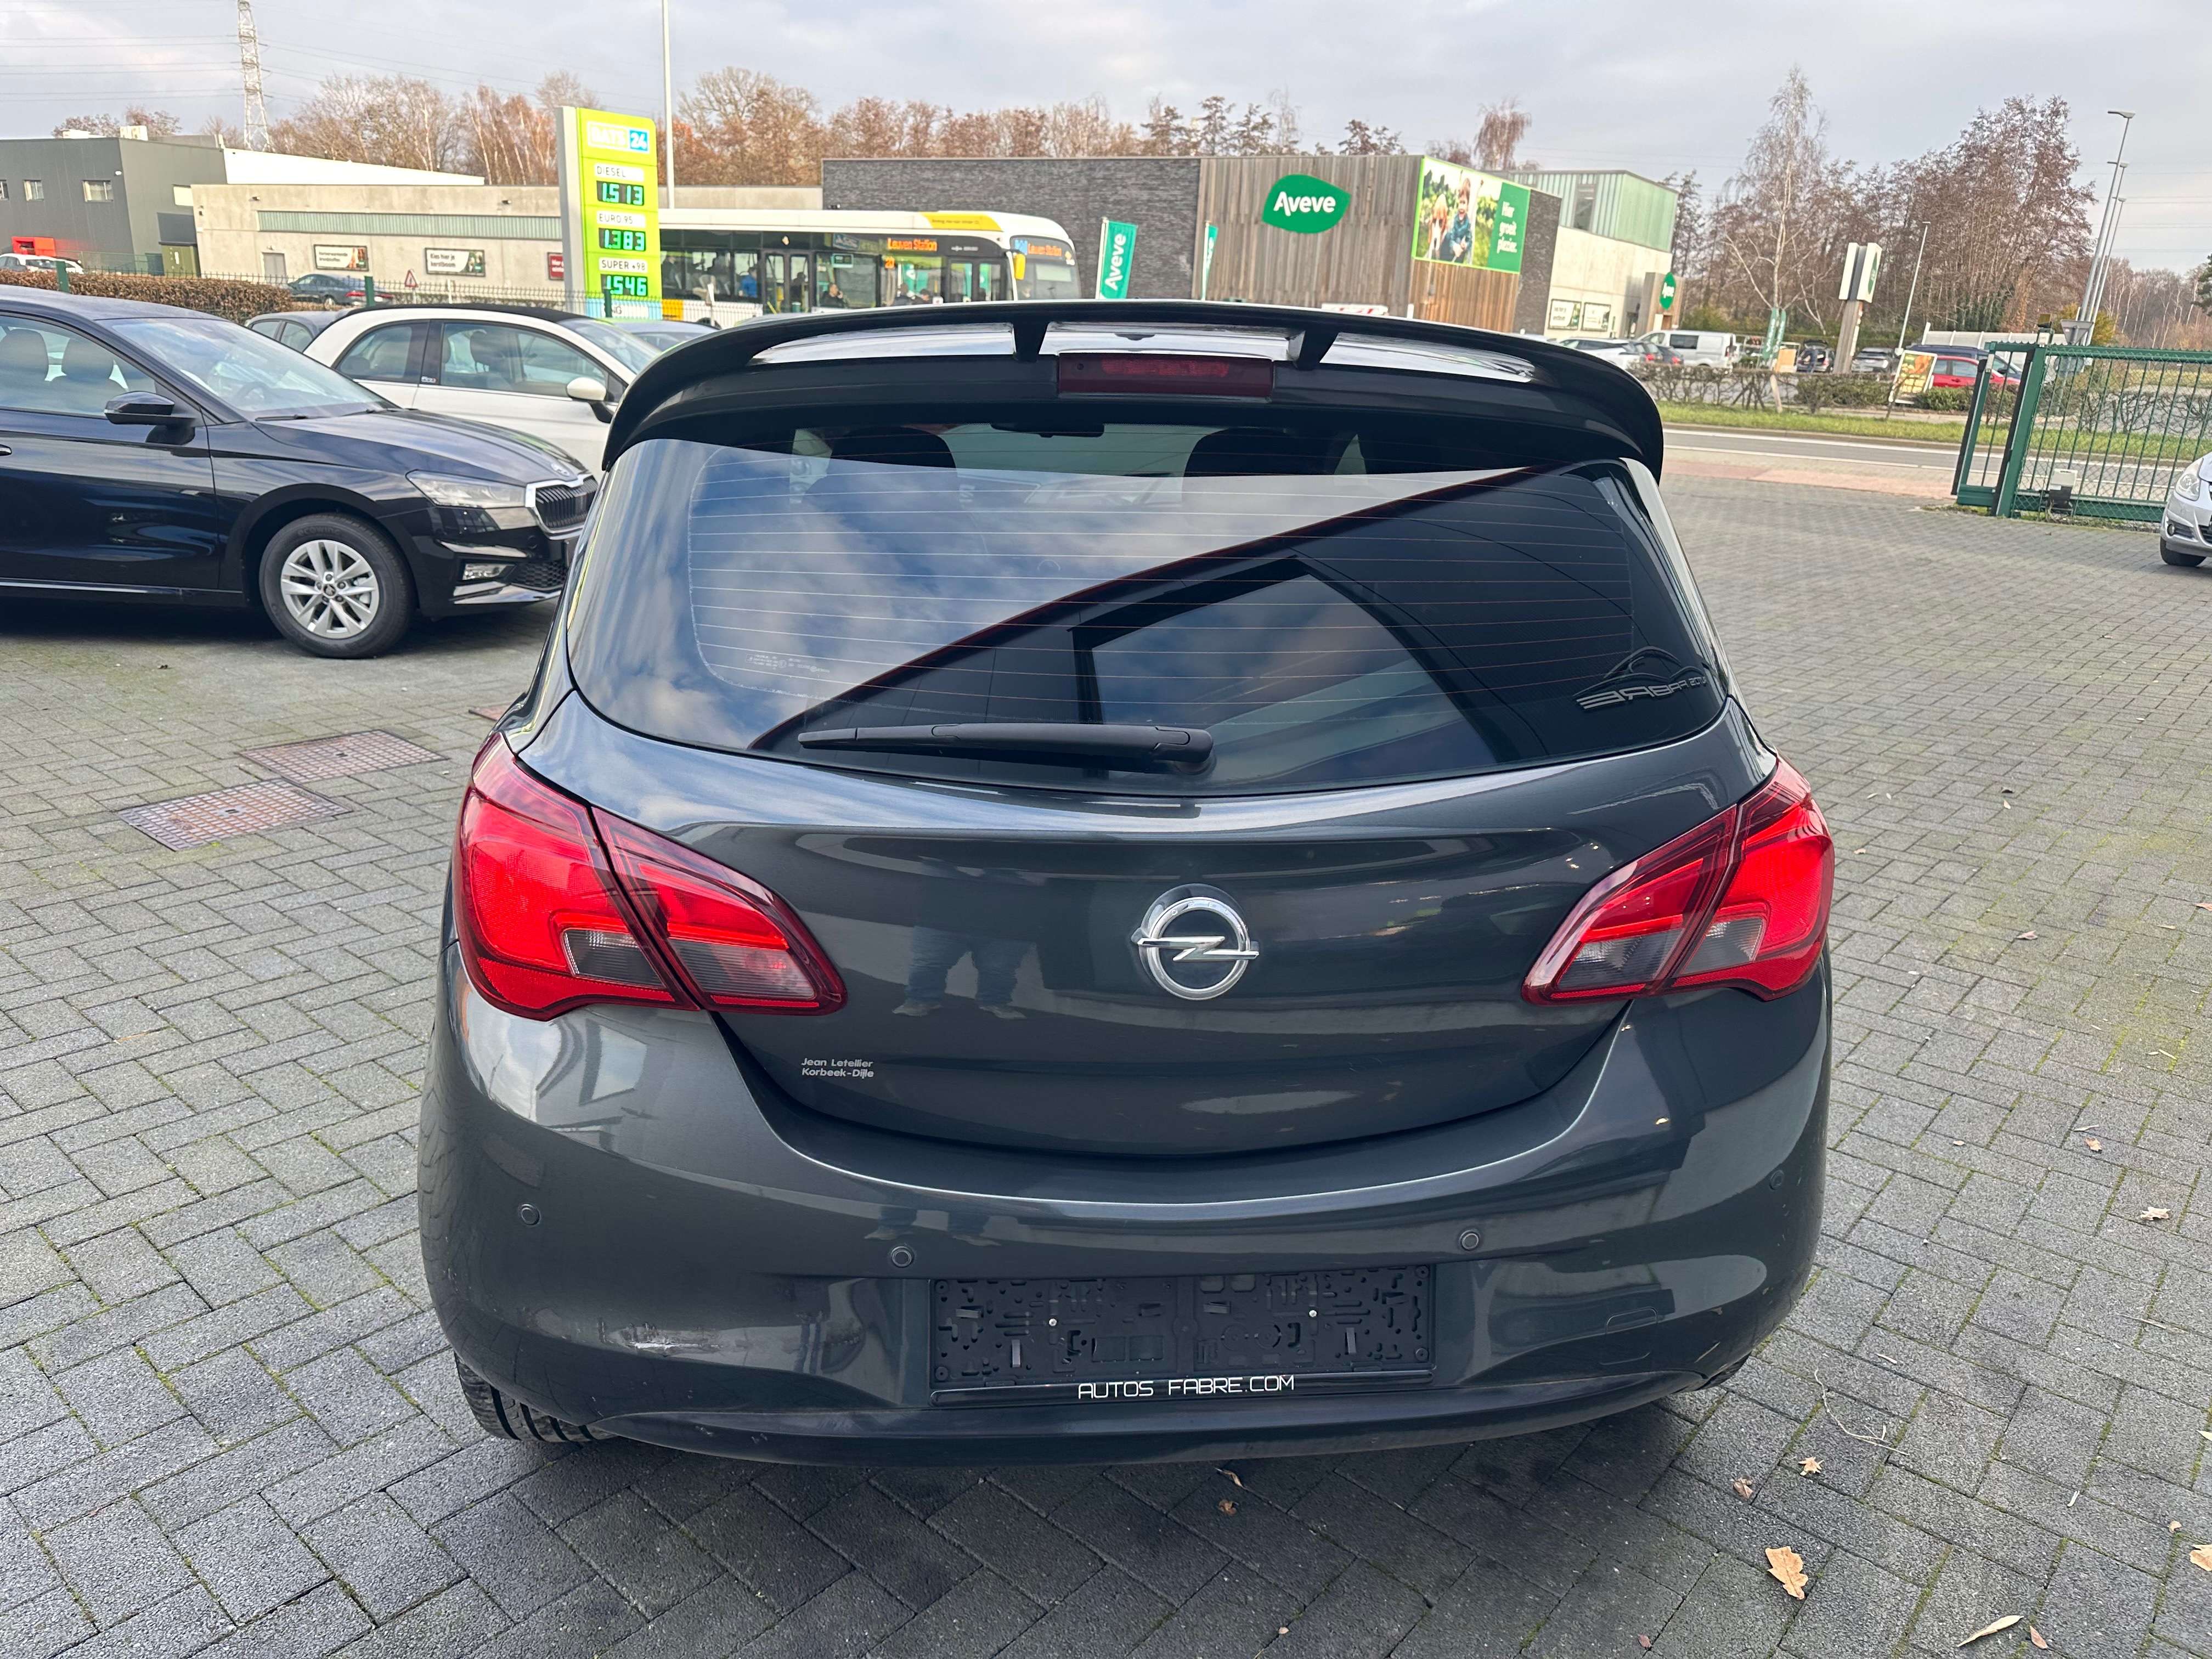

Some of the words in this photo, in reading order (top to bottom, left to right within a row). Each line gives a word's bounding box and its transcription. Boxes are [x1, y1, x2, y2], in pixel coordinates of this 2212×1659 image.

[630, 132, 647, 150] 24
[597, 166, 626, 177] DIESEL
[1273, 191, 1336, 217] Aveve
[602, 259, 629, 269] SUPER
[1105, 234, 1126, 290] Aveve
[802, 1058, 827, 1066] Jean
[831, 1059, 874, 1067] Letellier
[802, 1068, 874, 1079] Korbeek-Dijle
[1078, 1380, 1154, 1399] AUTOS
[1168, 1374, 1295, 1395] FABRE.COM
